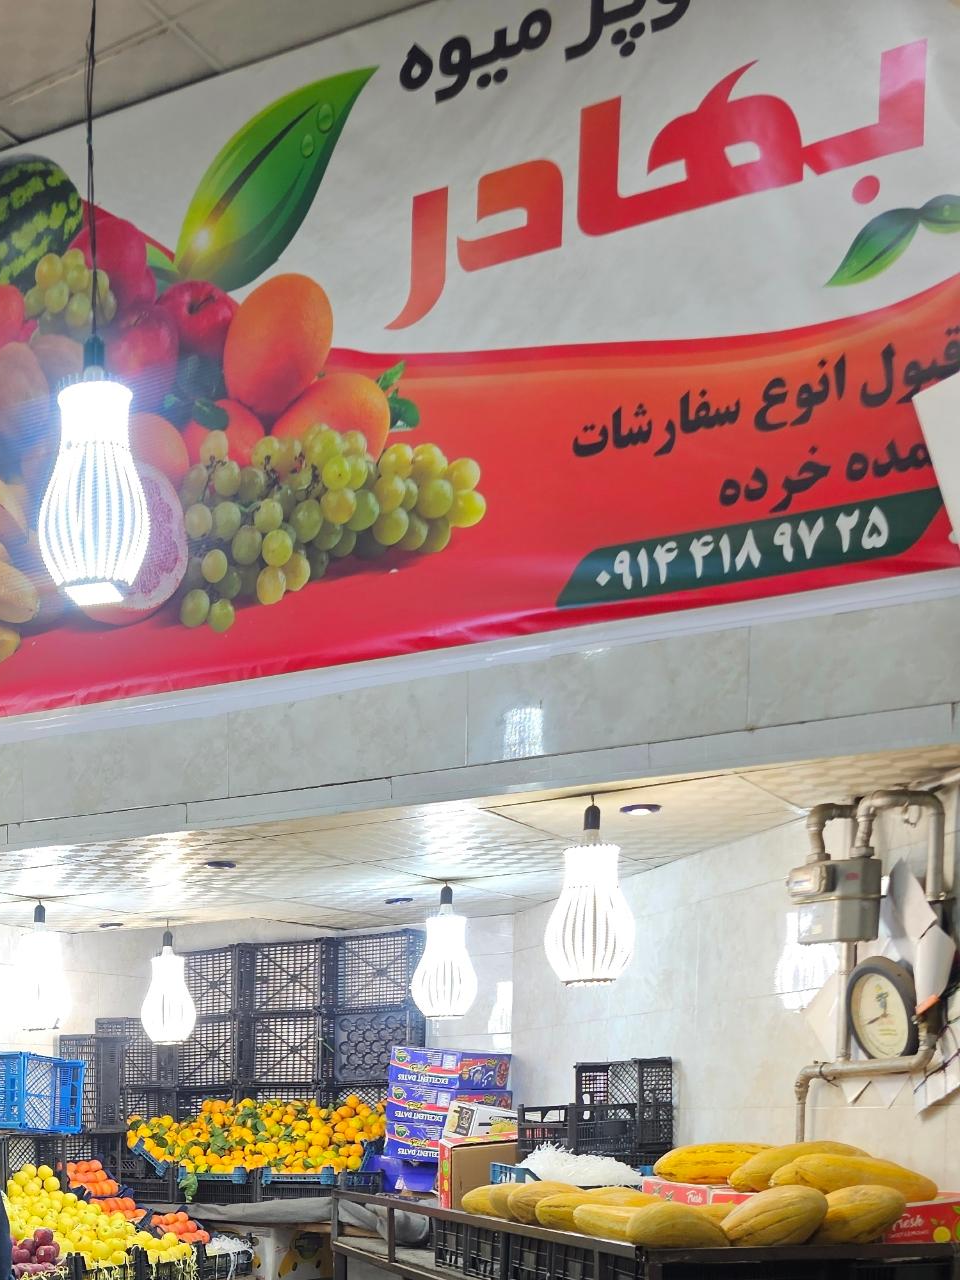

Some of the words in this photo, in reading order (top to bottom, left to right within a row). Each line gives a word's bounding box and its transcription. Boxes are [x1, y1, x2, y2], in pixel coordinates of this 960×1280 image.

[399, 8, 553, 105] میوه
[383, 37, 929, 332] بهادر
[753, 352, 847, 432] انوع
[571, 391, 742, 459] سفارشات
[718, 445, 832, 514] خرده
[844, 437, 934, 482] مده
[595, 532, 680, 592] ۰۹۱۴
[688, 525, 762, 577] ۴۱۸
[772, 514, 826, 562] ۹۷
[835, 505, 890, 554] ۲۵
[397, 1073, 417, 1083] DATES
[418, 1074, 449, 1085] EXCELLENT
[394, 1110, 413, 1119] DATES
[413, 1111, 443, 1122] EXCELLENT
[397, 1148, 416, 1157] DATES
[416, 1149, 439, 1158] CELLENT
